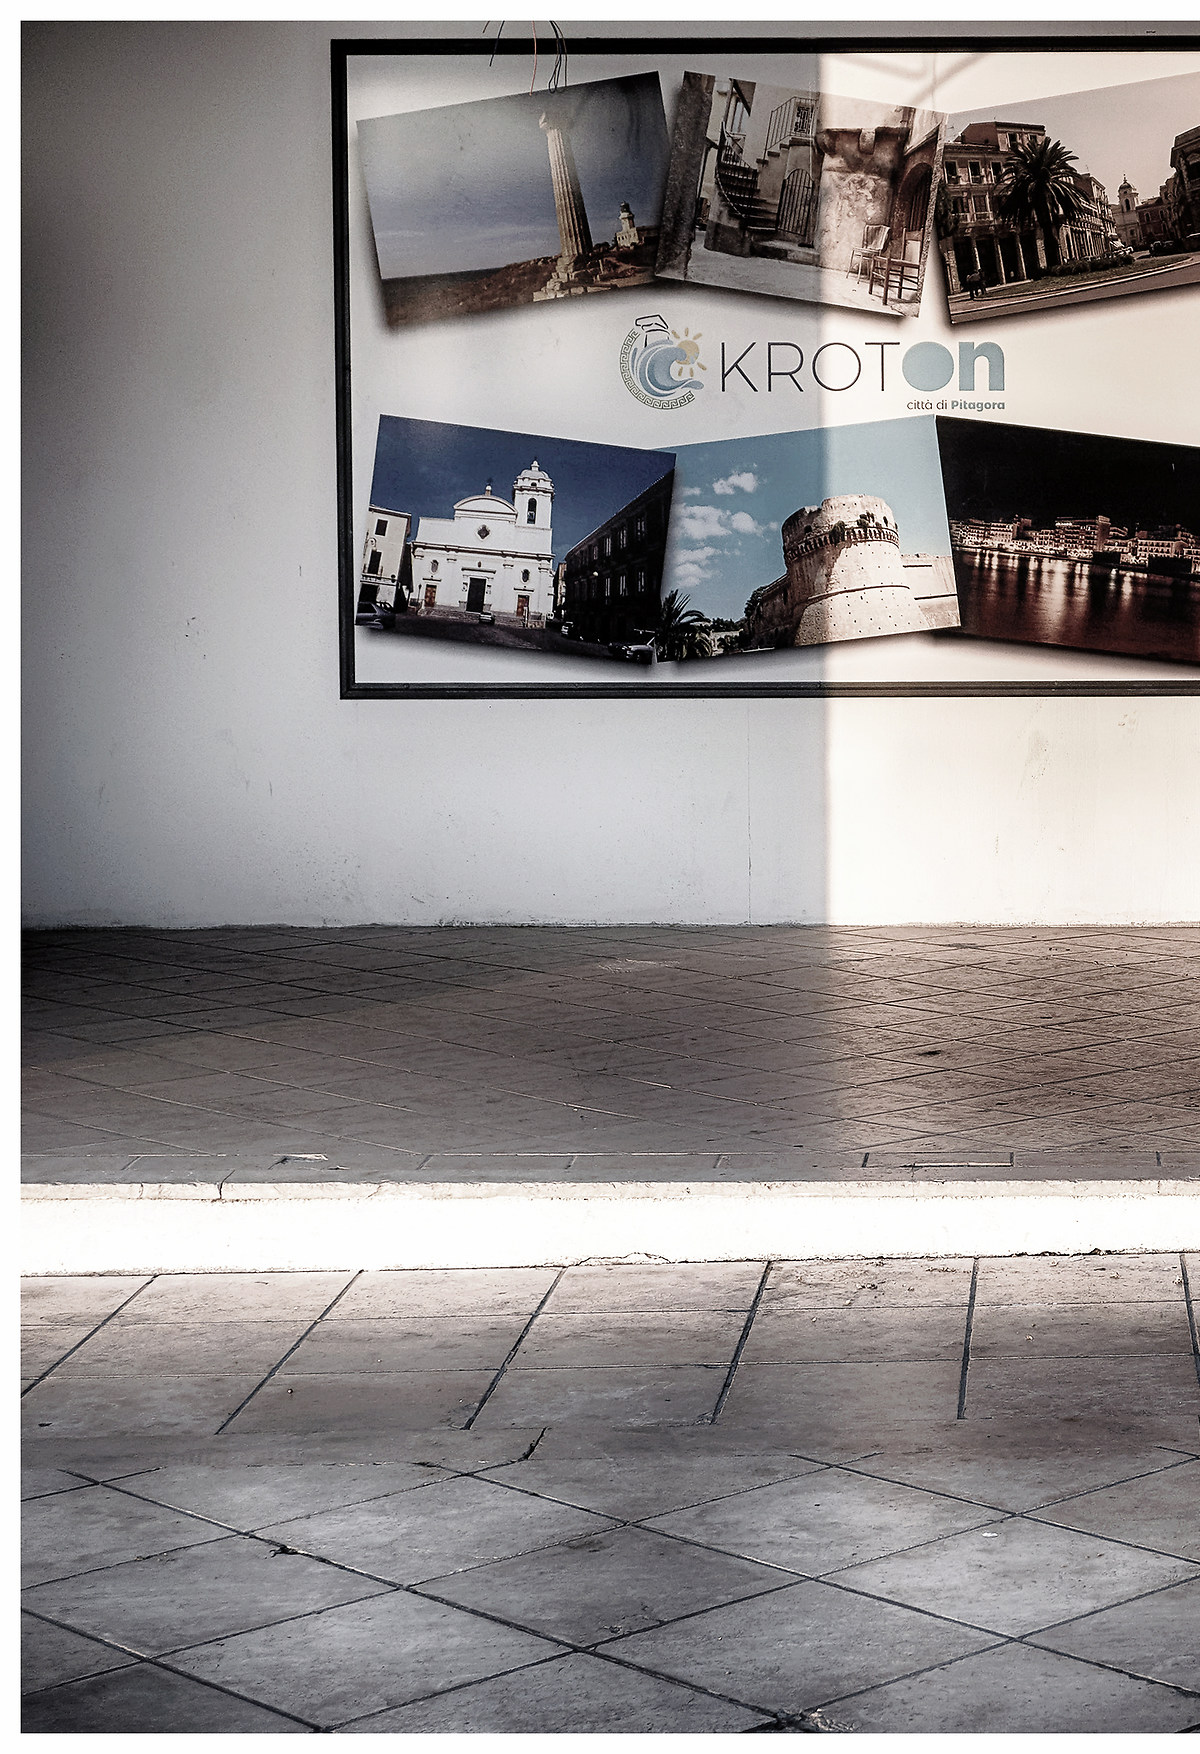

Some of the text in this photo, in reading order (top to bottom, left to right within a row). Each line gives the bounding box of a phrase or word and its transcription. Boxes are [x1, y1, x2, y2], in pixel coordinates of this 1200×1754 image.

[906, 399, 1006, 413] città di Pitagora
